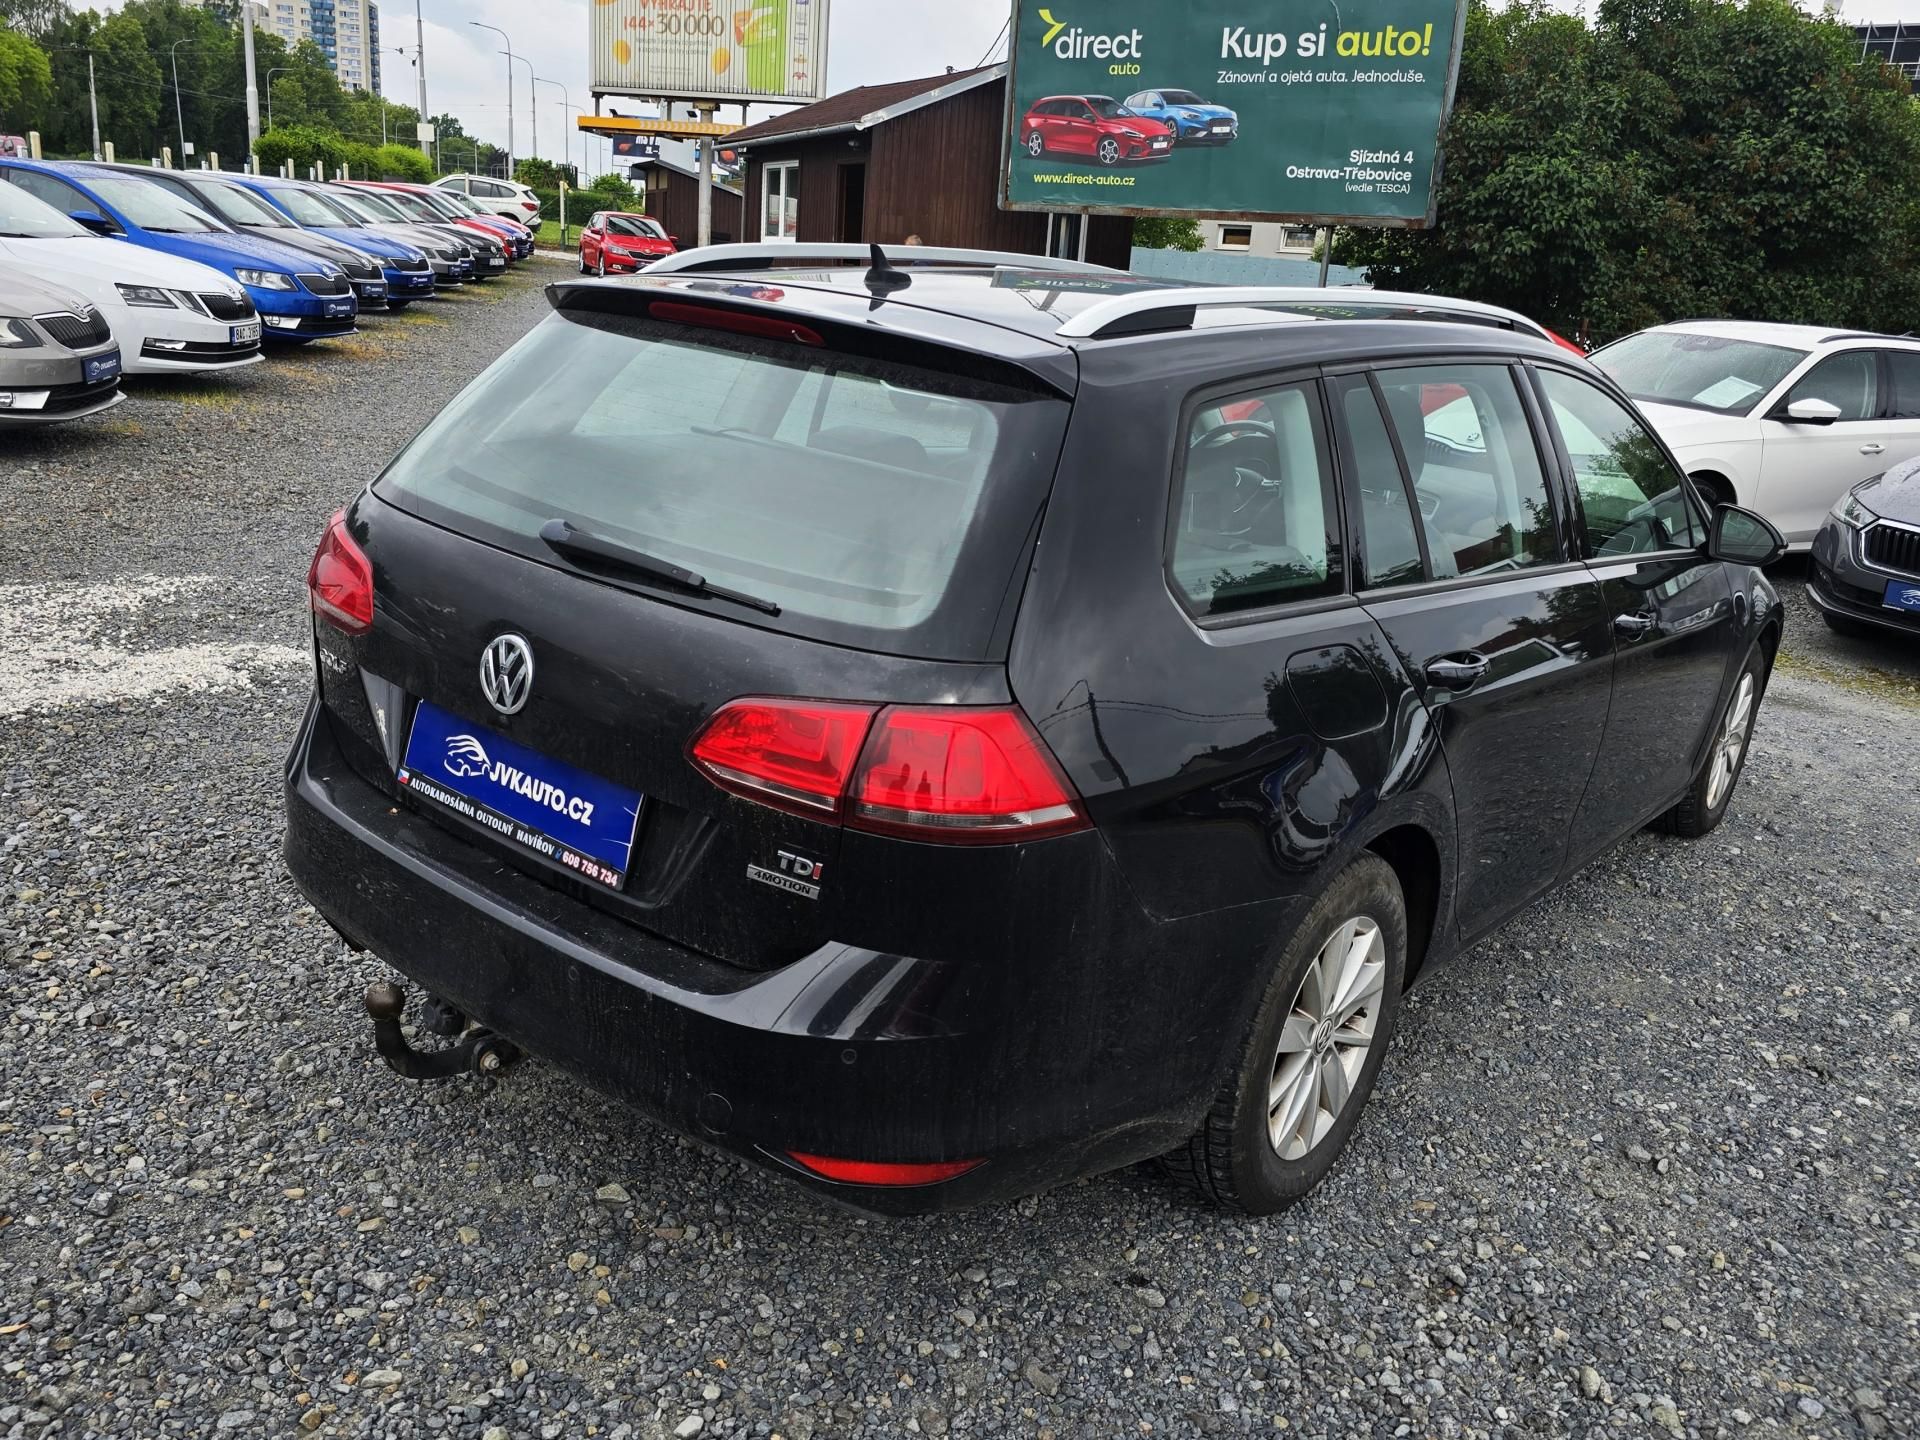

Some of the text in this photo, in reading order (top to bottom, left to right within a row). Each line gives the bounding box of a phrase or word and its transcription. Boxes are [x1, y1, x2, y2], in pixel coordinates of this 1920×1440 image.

[1055, 27, 1143, 59] direct
[1221, 22, 1433, 66] Kup si auto!
[1109, 62, 1140, 75] auto
[1217, 69, 1425, 86] Zánovní a ojetá auta. Jednoduše.
[1349, 149, 1414, 165] Sjízdná 4
[1033, 173, 1135, 186] www.direct-auto.cz
[1286, 165, 1412, 181] Ostrava-Třebovice
[1345, 182, 1410, 194] (vedle TESCA)
[489, 761, 595, 827] JVKAUTO.CZ
[410, 777, 618, 887] AUTOKAROSÁRNA OUTOLNÝ HAVÍŘOV 608 756 734
[777, 849, 822, 880] TDI
[753, 870, 812, 895] 4MOTION
